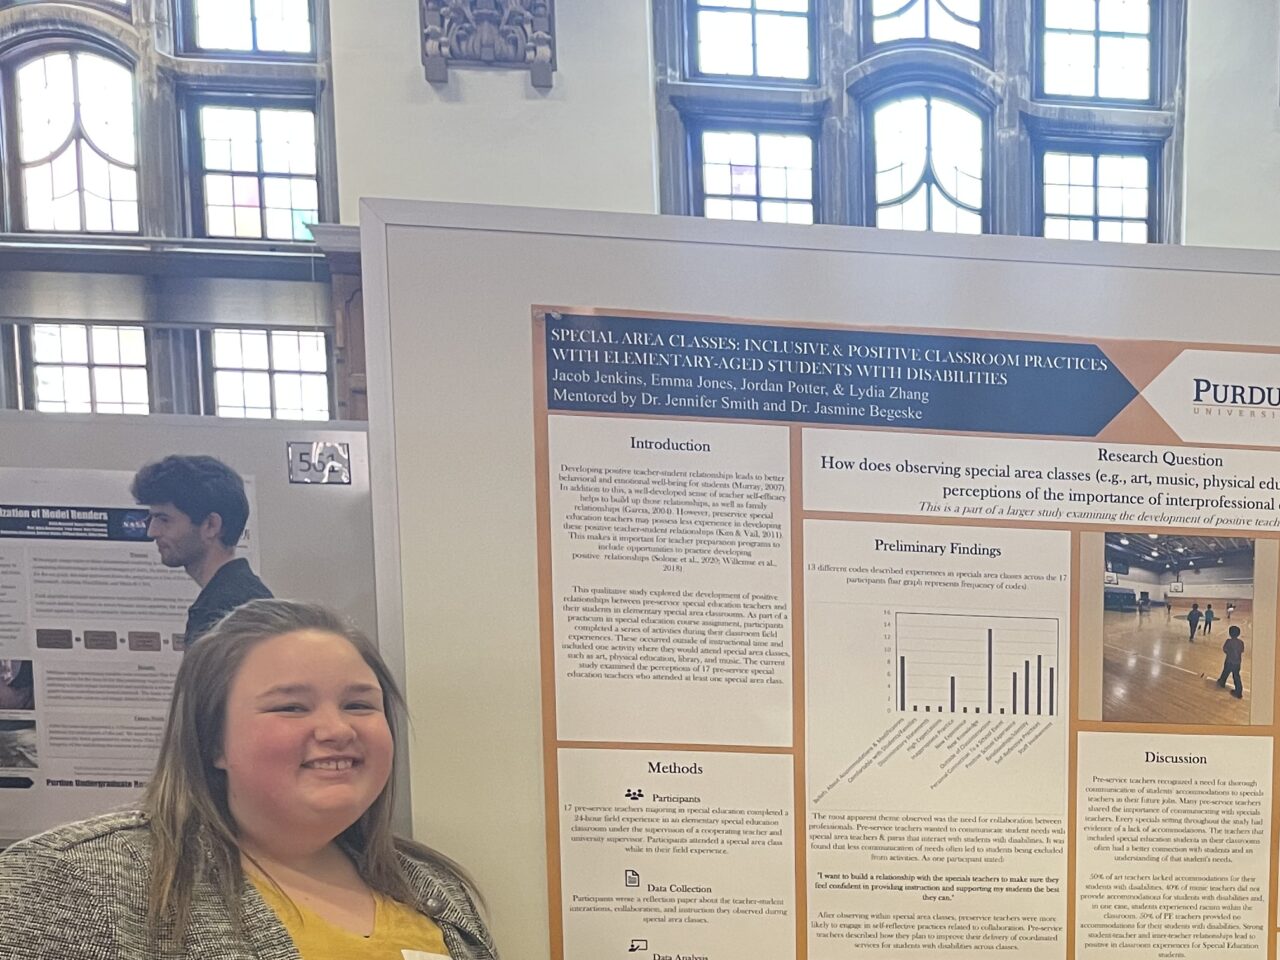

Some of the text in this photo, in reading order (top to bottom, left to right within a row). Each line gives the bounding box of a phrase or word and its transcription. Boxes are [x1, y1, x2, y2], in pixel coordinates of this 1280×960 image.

[551, 328, 1109, 370] SPECIAL AREA CLASSES: INCLUSIVE & POSITIVE CLASSROOM PRACTICES
[551, 347, 1008, 384] WITH ELEMENTARY-AGED STUDENTS WITH DISABILITIES
[551, 368, 930, 403] Jacob Jenkins, Emma Jones, Jordan Potter, & Lydia Zhang
[553, 388, 922, 420] Mentored by Dr. Jennifer Smith and Dr. Jasmine Begeske
[630, 436, 711, 451] Introduction
[1097, 447, 1223, 466] Research Question
[560, 464, 603, 474] Developing
[603, 467, 632, 475] positive
[632, 468, 688, 477] teacher-student
[688, 470, 734, 479] relationships
[734, 471, 754, 480] leads
[763, 473, 785, 481] better
[820, 455, 855, 469] How
[858, 457, 891, 471] does
[895, 459, 961, 478] observing
[964, 464, 1010, 479] special
[1014, 469, 1043, 479] area
[1046, 466, 1091, 481] classes
[1095, 468, 1127, 485] (e.g.,
[1130, 473, 1152, 485] art,
[1156, 473, 1199, 488] music,
[1202, 474, 1255, 490] physical
[942, 485, 1021, 500] perceptions
[1025, 486, 1041, 499] of
[1043, 487, 1064, 501] the
[1068, 489, 1144, 505] importance
[1148, 492, 1164, 505] of
[1165, 493, 1275, 510] interprofessional
[42, 509, 69, 519] Model
[71, 510, 108, 520] Renders
[918, 501, 941, 511] This
[943, 504, 952, 512] is
[961, 506, 983, 515] part
[984, 504, 997, 515] of
[996, 504, 1004, 515] a
[1006, 505, 1035, 517] larger
[1036, 507, 1064, 518] study
[1065, 511, 1118, 521] examining
[1118, 510, 1135, 520] the
[1136, 511, 1201, 524] development
[1202, 514, 1215, 525] of
[1213, 514, 1253, 526] positive
[874, 538, 1002, 558] Preliminary Findings
[1144, 751, 1207, 763] Discussion
[647, 761, 703, 774] Methods
[652, 793, 701, 803] Participants
[816, 871, 823, 879] "I
[849, 872, 869, 880] build
[875, 873, 916, 881] relationship
[944, 874, 971, 882] specials
[1044, 875, 1060, 884] they
[647, 883, 712, 893] Data Collection
[652, 953, 673, 960] Data
